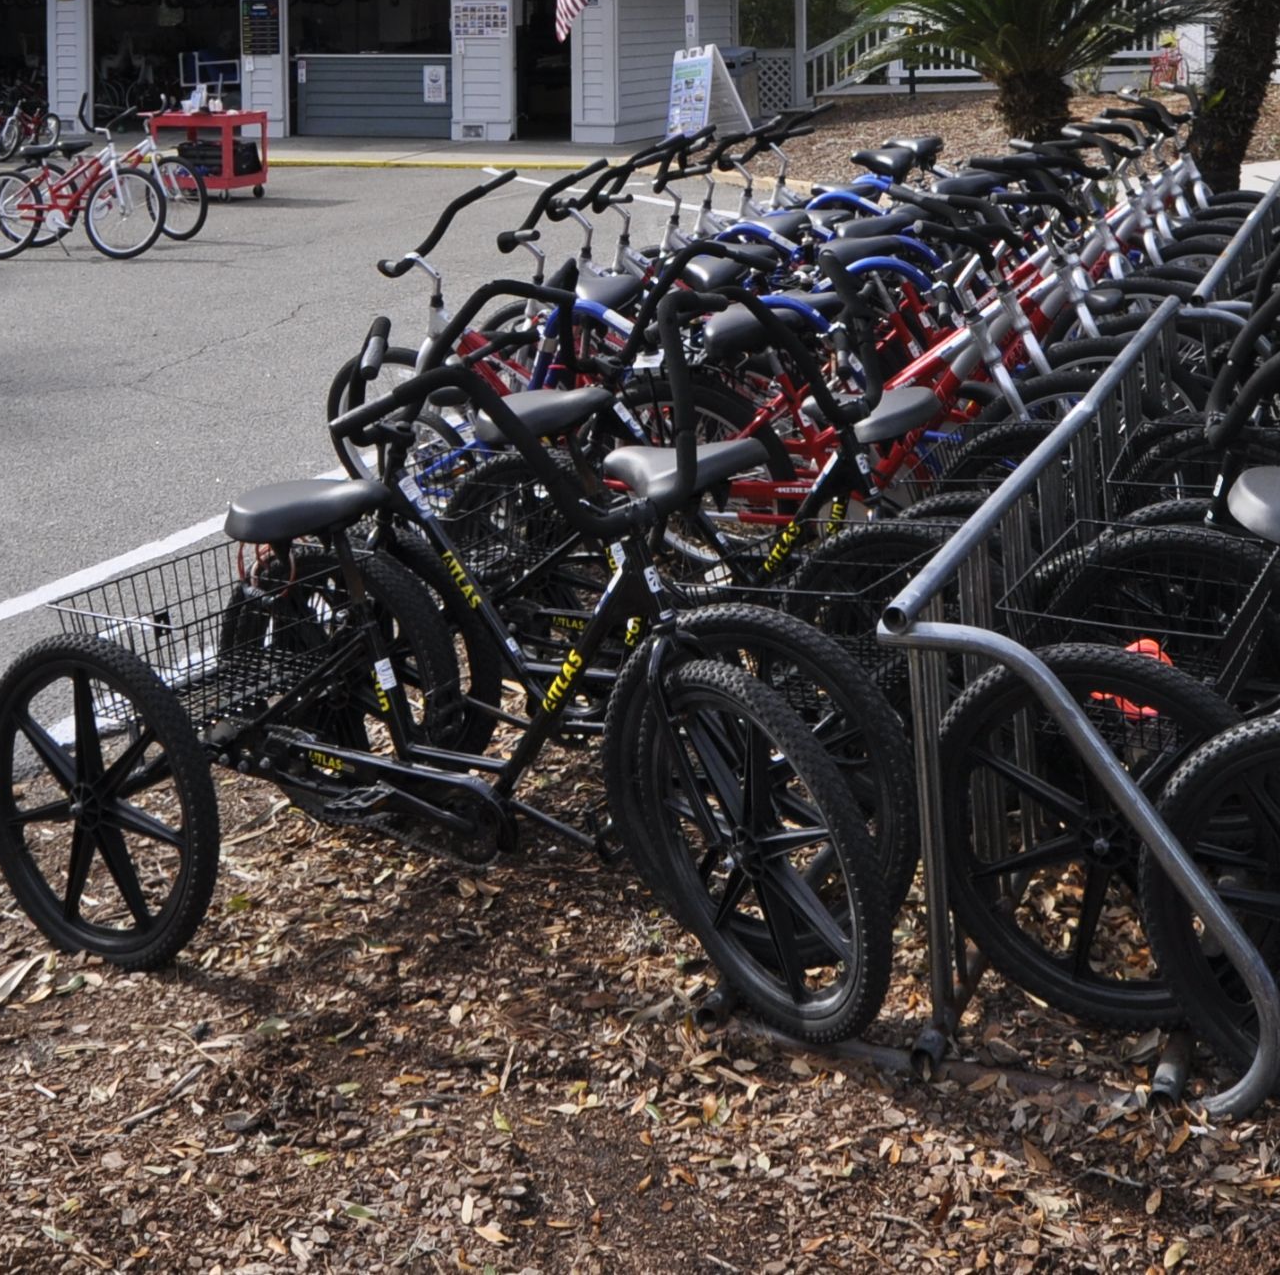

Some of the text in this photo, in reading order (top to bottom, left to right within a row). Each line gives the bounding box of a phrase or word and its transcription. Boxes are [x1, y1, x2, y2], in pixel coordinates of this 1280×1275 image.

[763, 521, 801, 572] ATLAS
[441, 550, 482, 609] ATLAS
[542, 648, 583, 712] ATLAS
[308, 750, 342, 771] ATLAS
